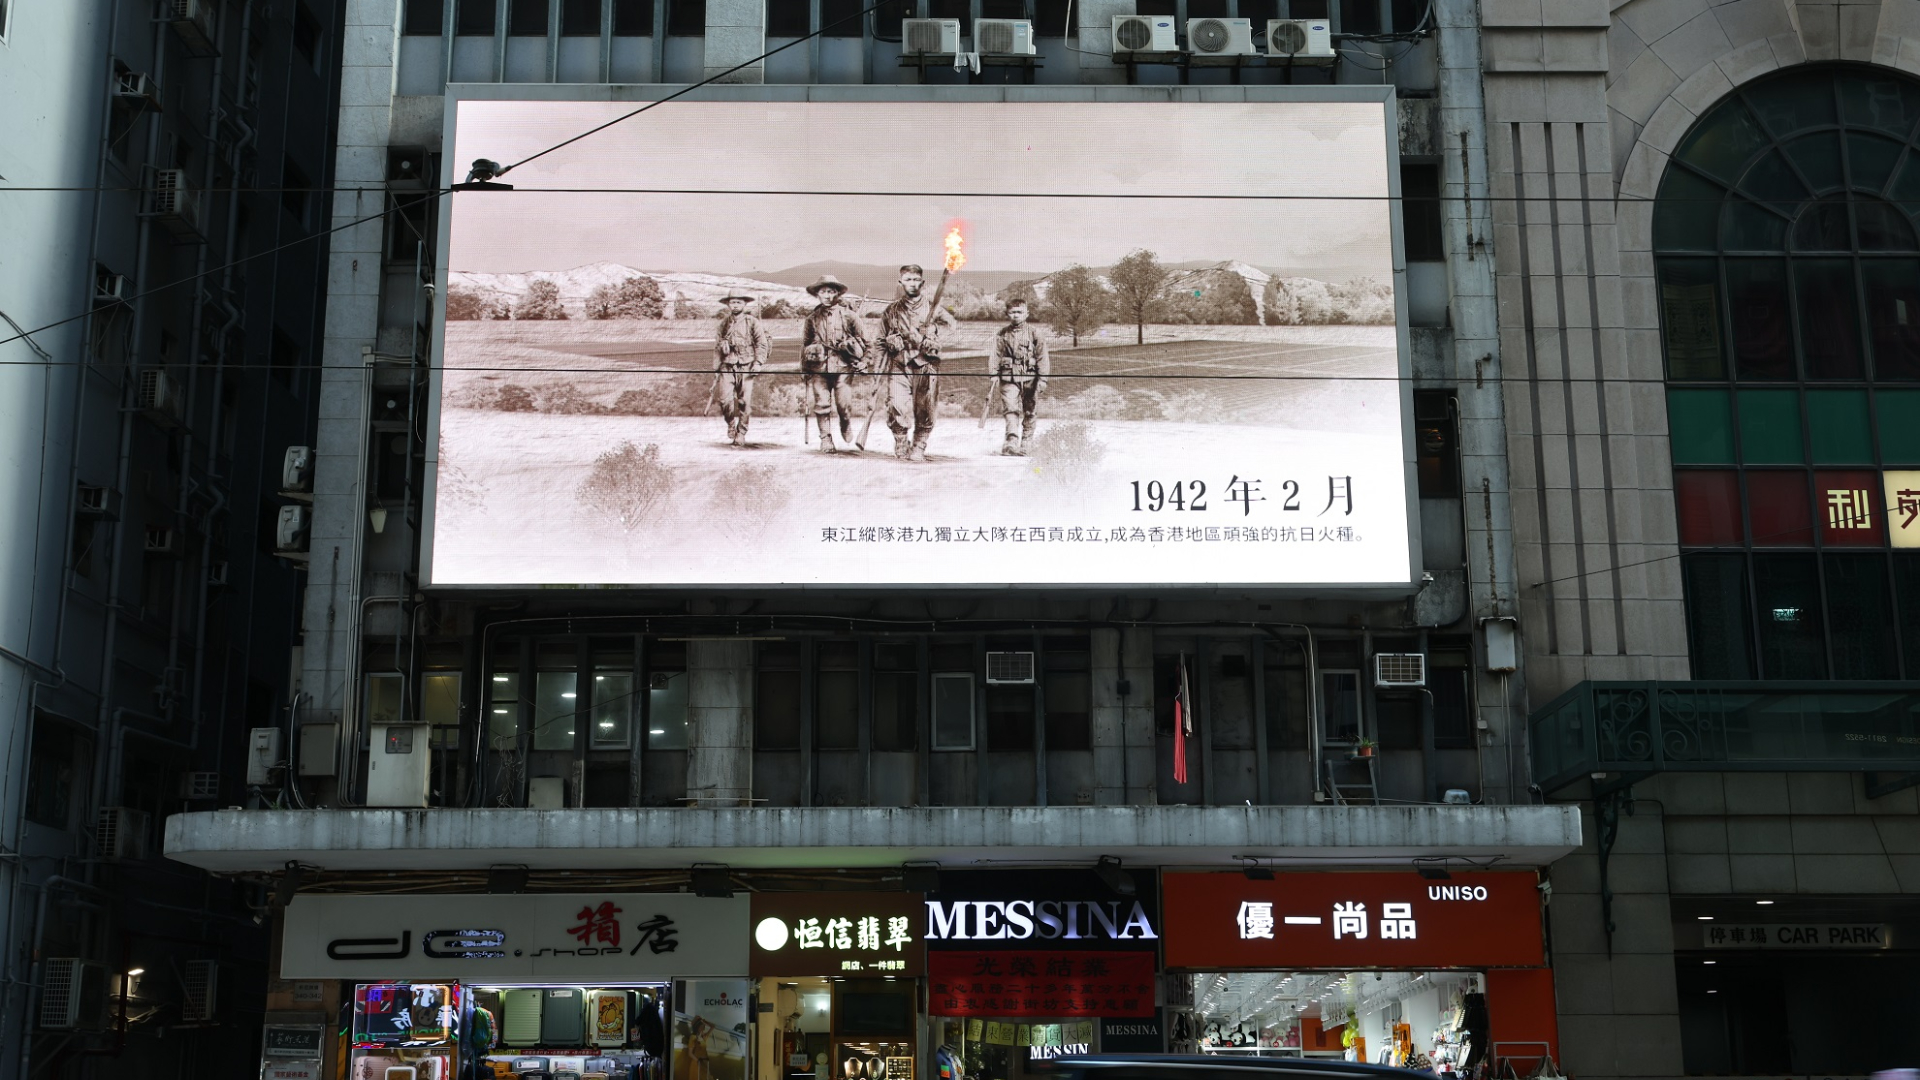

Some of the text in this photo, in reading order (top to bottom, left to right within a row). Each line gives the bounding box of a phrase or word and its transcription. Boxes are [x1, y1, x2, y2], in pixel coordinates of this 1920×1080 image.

[1130, 474, 1353, 517] 1942 年 2 月
[1428, 885, 1488, 901] UNISO
[923, 900, 1159, 940] MESSINA
[1236, 901, 1417, 940] 優一尚品
[794, 915, 912, 952] 恒信翡翠
[1709, 926, 1880, 944] 停車場 CAR PARK
[973, 956, 1110, 978] 光榮結業
[704, 998, 743, 1006] ECHOLAC
[1106, 1025, 1159, 1035] MESSINA
